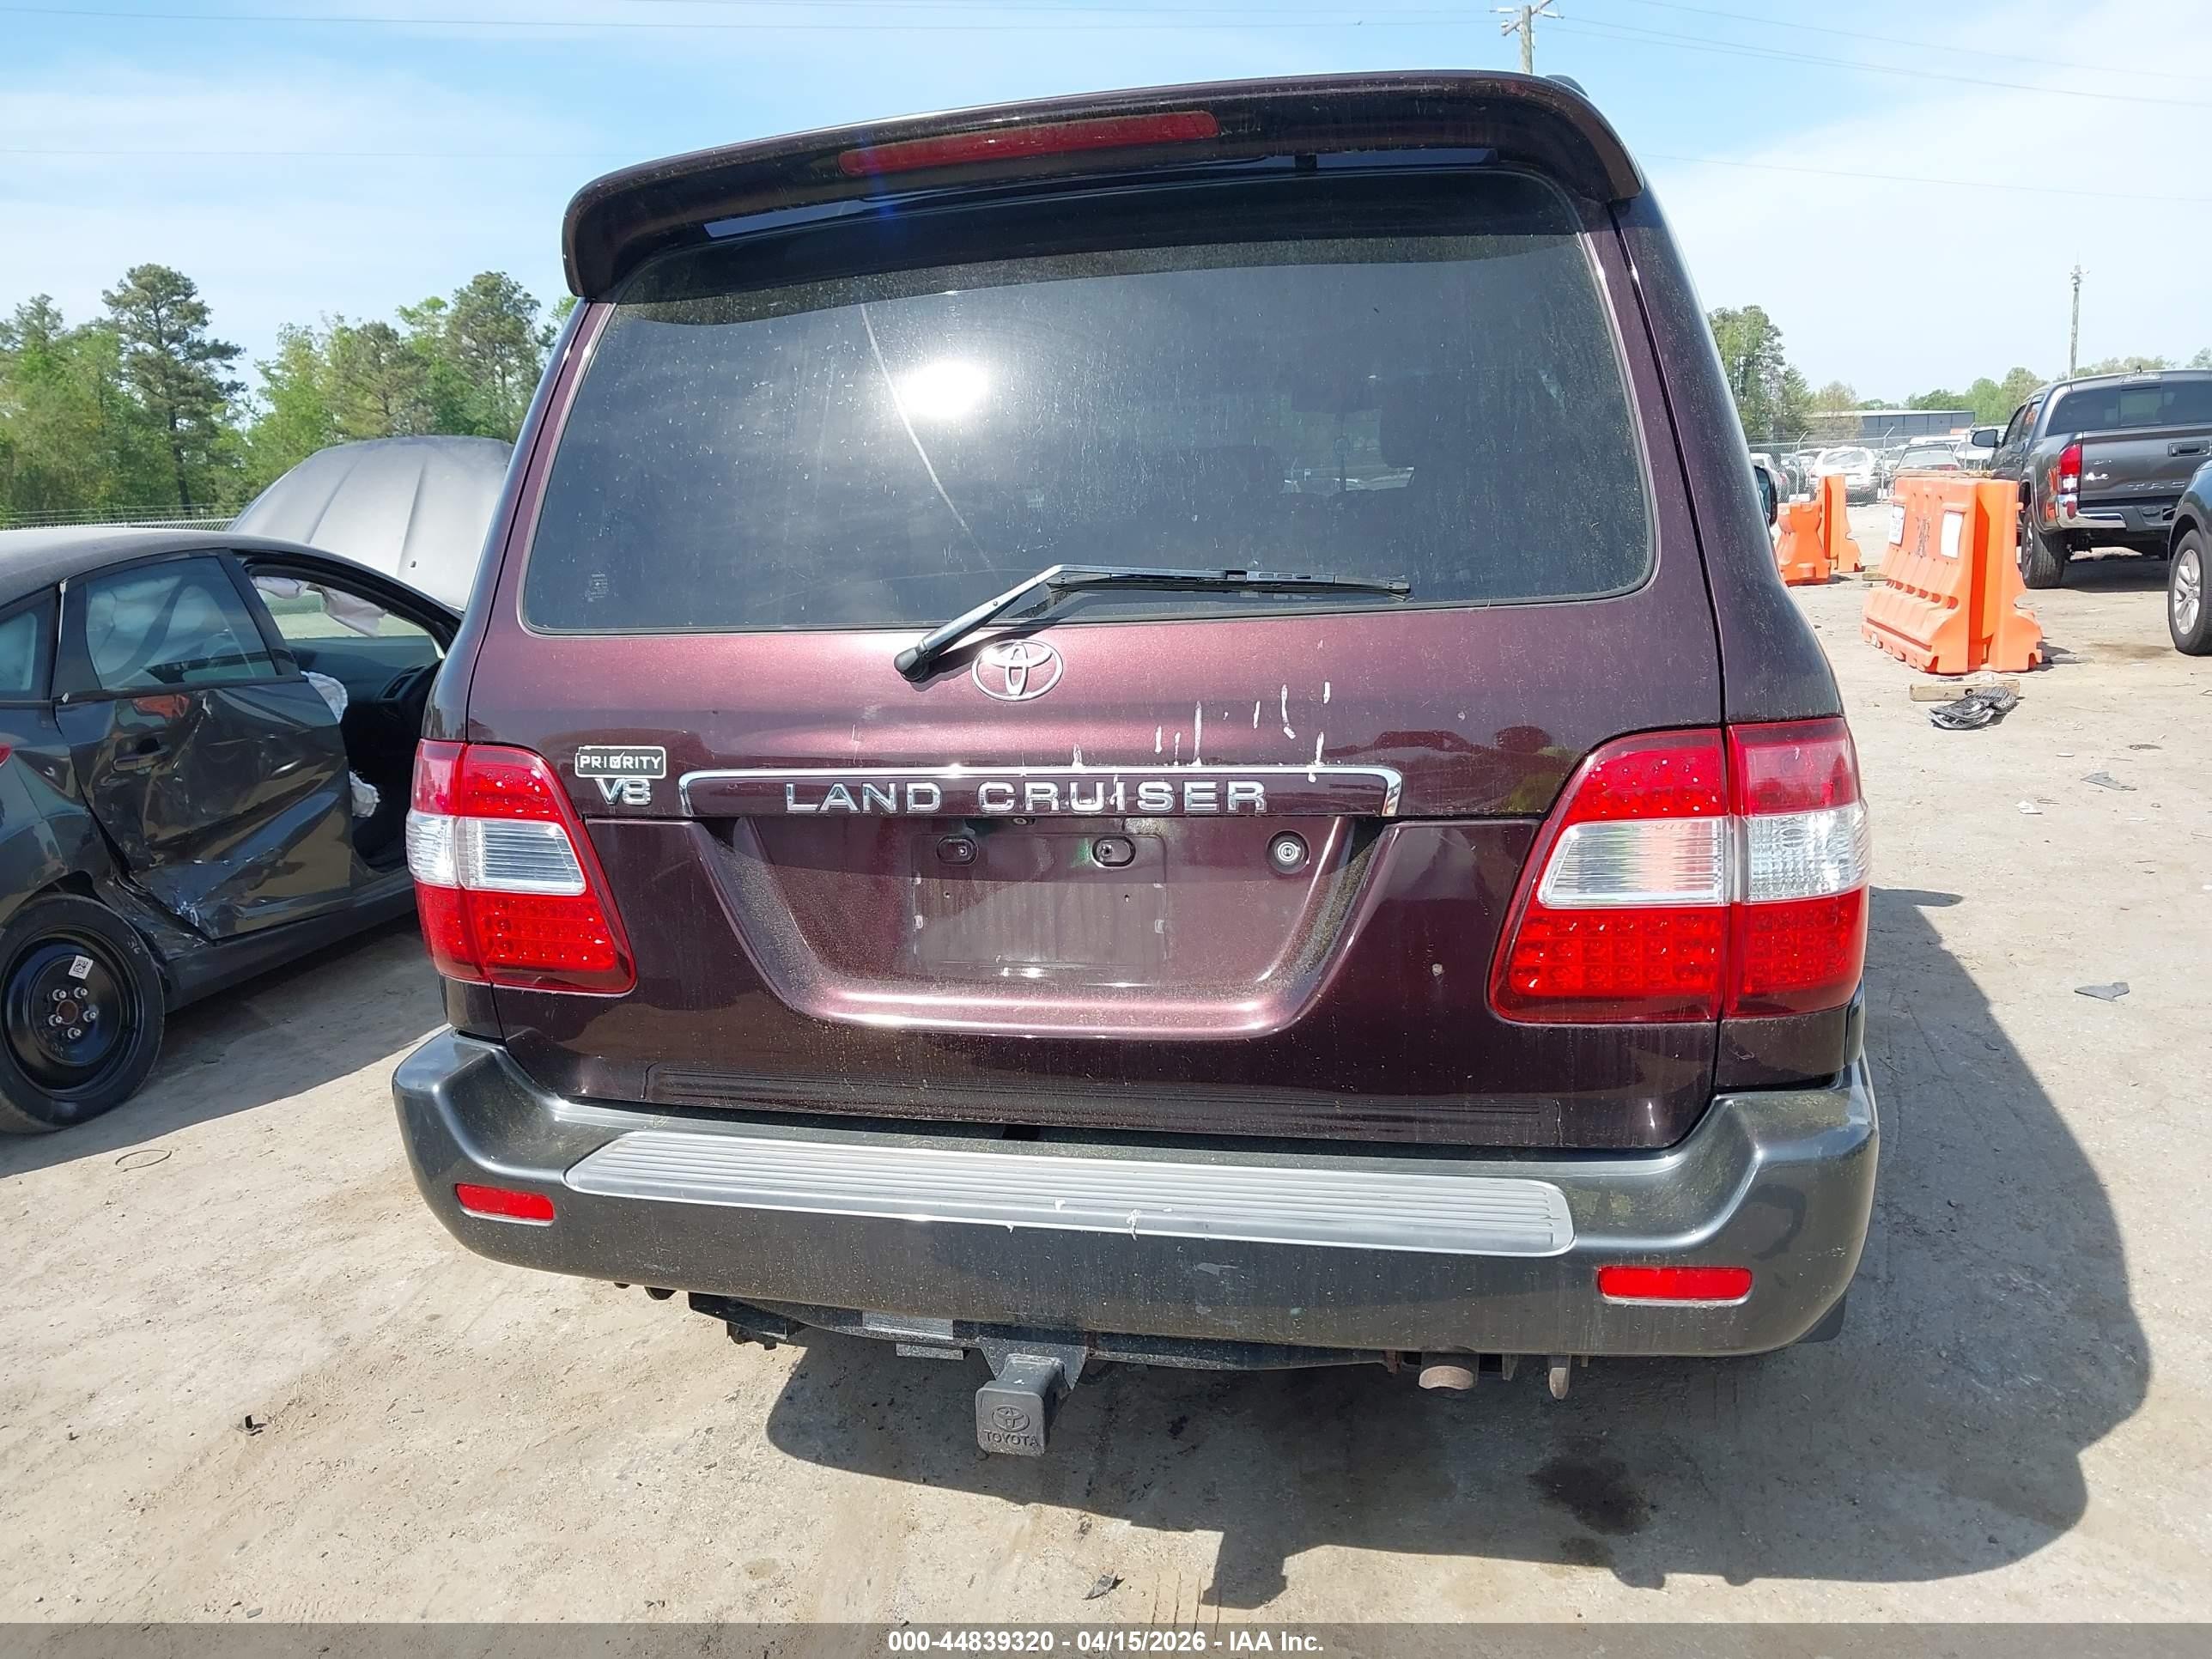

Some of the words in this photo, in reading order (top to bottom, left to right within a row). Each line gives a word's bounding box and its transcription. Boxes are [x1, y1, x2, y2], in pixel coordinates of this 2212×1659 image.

[580, 752, 662, 770] PRIORITY
[594, 778, 651, 805] V8
[785, 782, 942, 813] LAND
[977, 781, 1267, 813] CRUISER
[981, 1429, 1039, 1448] TOYOTA
